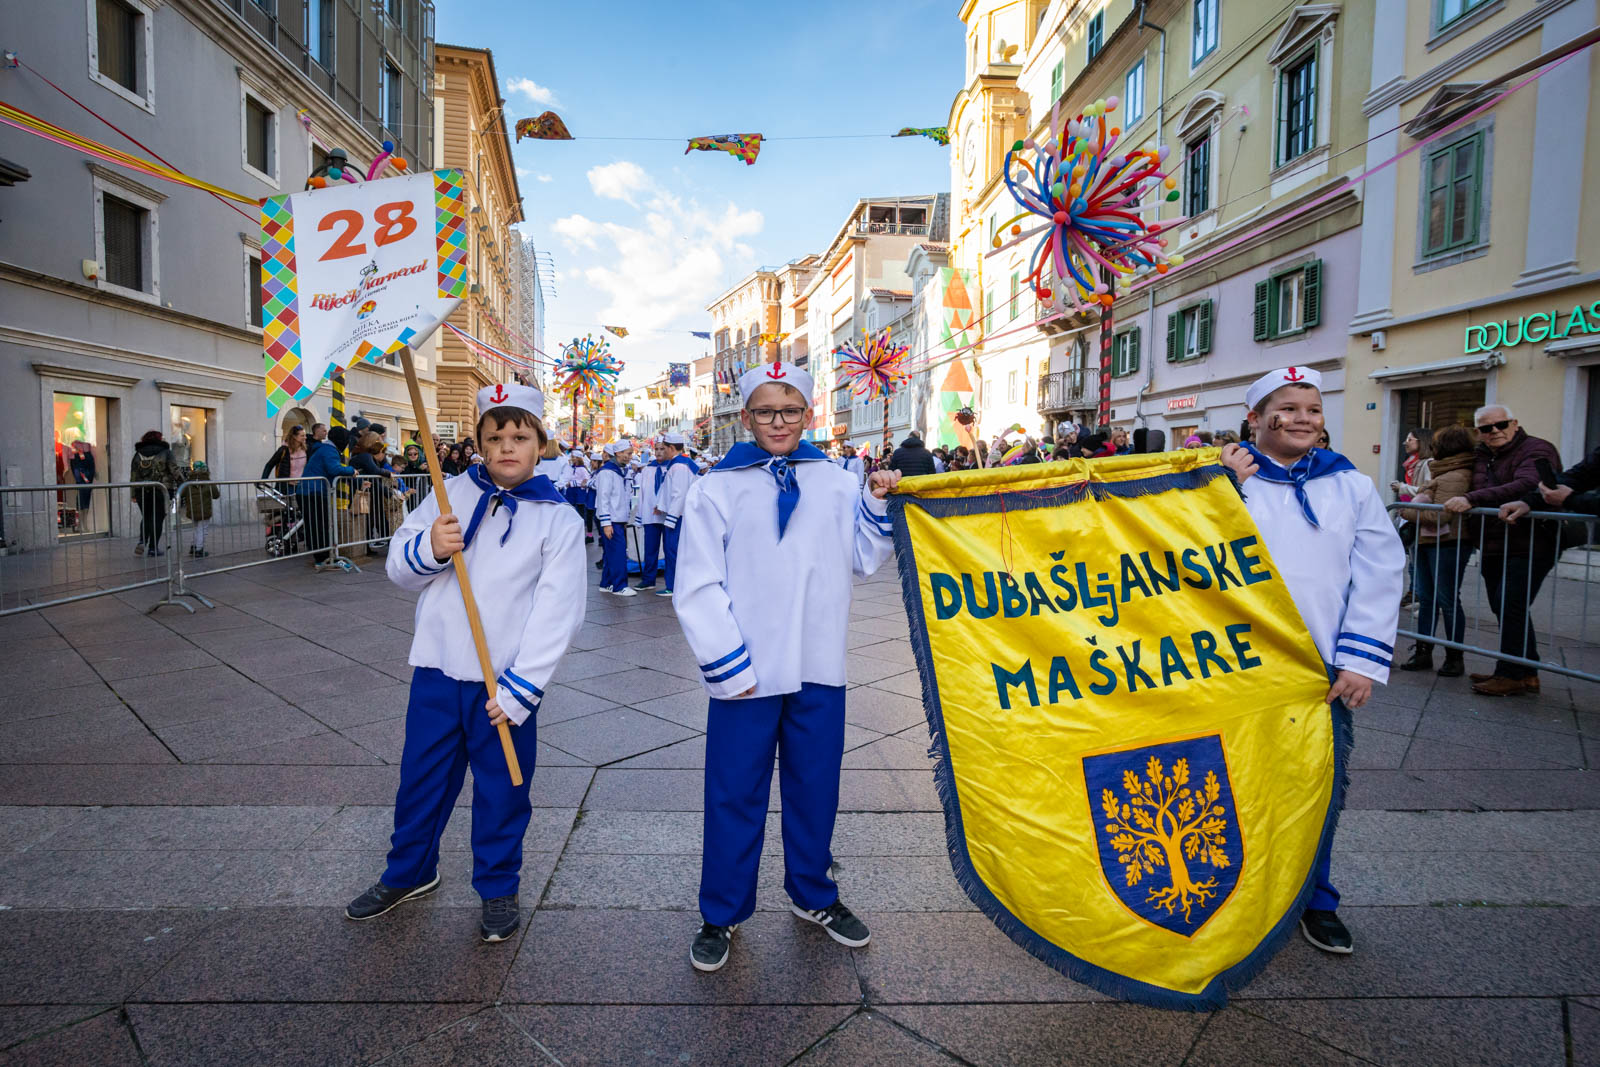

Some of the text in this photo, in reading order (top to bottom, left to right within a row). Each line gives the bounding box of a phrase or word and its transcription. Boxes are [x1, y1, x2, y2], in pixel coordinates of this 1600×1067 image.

[317, 200, 418, 262] 28
[352, 319, 380, 335] RIJEKA
[1464, 300, 1600, 354] DOUGLAS
[991, 623, 1262, 710] MAŠKARE
